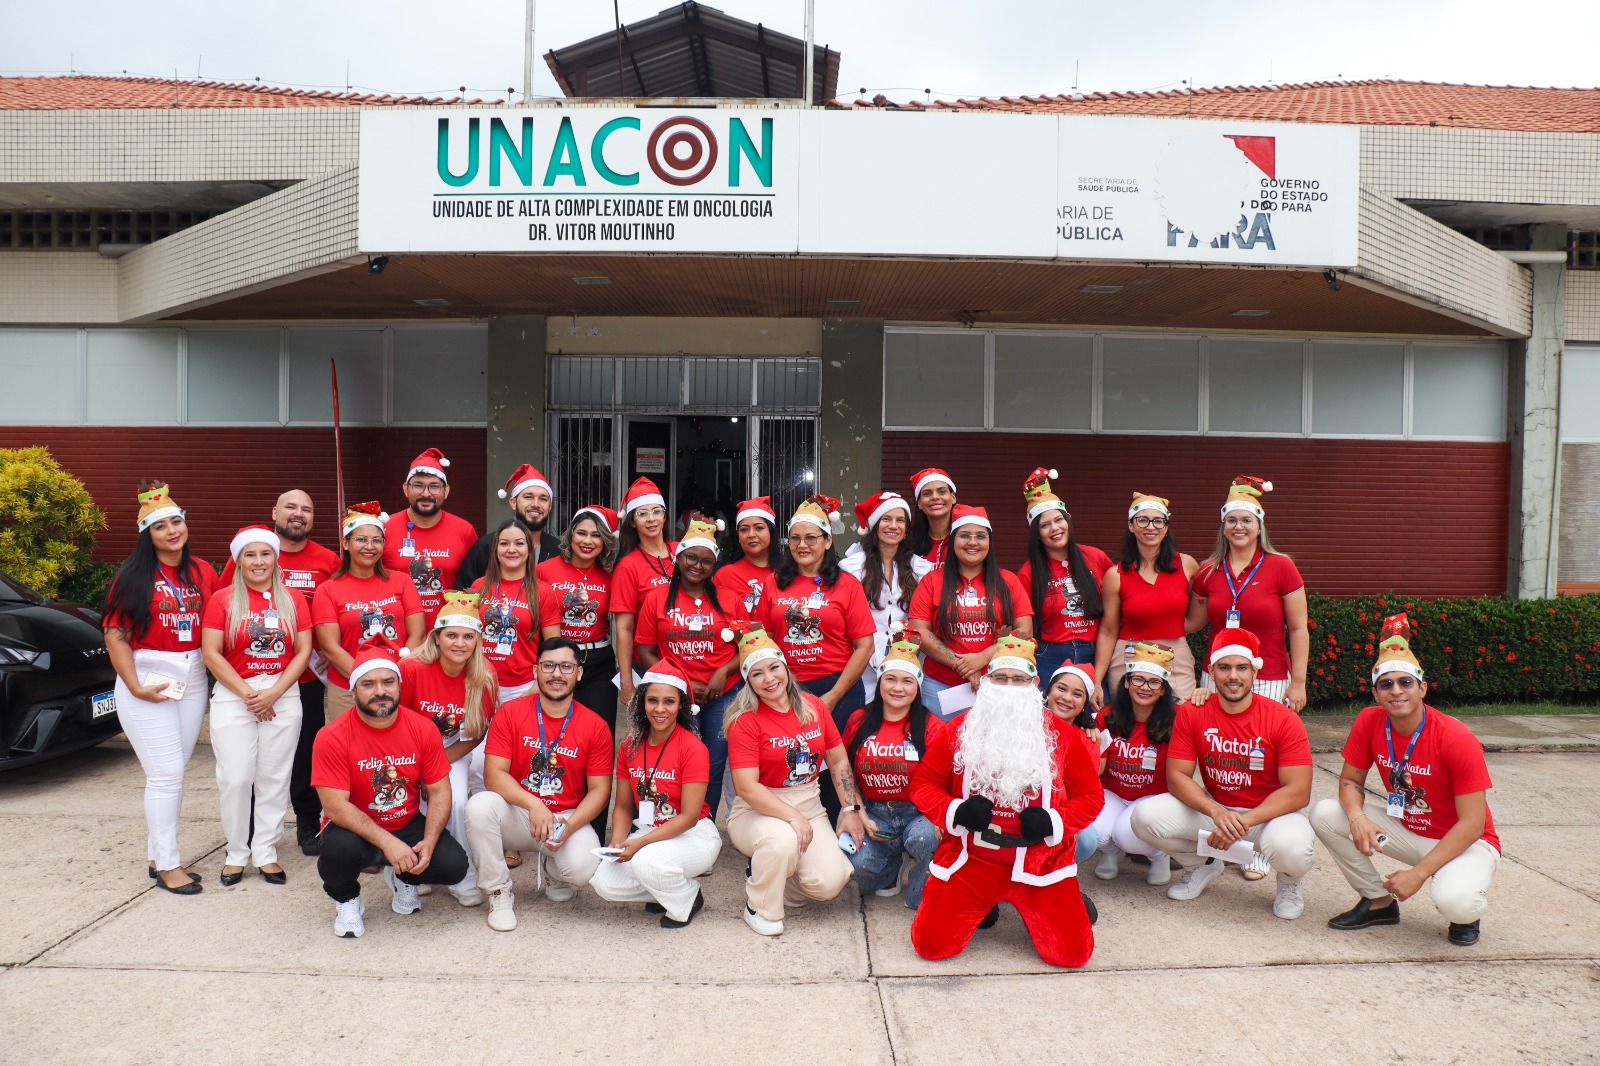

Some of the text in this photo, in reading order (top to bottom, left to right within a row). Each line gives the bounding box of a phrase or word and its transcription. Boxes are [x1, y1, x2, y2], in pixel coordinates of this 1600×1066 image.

[437, 115, 773, 187] UNACON
[1078, 184, 1139, 193] SAÚDE PÚBLICA
[1260, 178, 1320, 190] GOVERNO
[1260, 190, 1328, 202] DO ESTADO
[433, 199, 773, 218] UNIDADE DE ALTA COMPLEXIDADE EM ONCOLOGIA
[1093, 206, 1113, 220] DE
[1281, 200, 1312, 213] PARÁ
[528, 223, 674, 241] DR. VITOR MOUTINHO
[423, 548, 450, 558] Natal
[289, 571, 312, 580] JUNHO
[285, 579, 316, 588] VERMELHO
[551, 581, 606, 592] Feliz Natal
[345, 594, 397, 611] Feliz Natal
[778, 596, 799, 608] Feliz
[669, 612, 714, 626] Naal
[669, 640, 714, 655] UNACON
[788, 647, 823, 657] UNACON
[246, 661, 282, 670] UNACON
[420, 700, 446, 717] Feliz
[769, 735, 796, 749] Feliz
[863, 740, 904, 757] Nata
[1206, 733, 1253, 756] Natal
[357, 753, 416, 771] Feliz Natal
[1404, 762, 1432, 776] Natal
[861, 773, 909, 788] UNACON
[1205, 765, 1252, 787] UNACON
